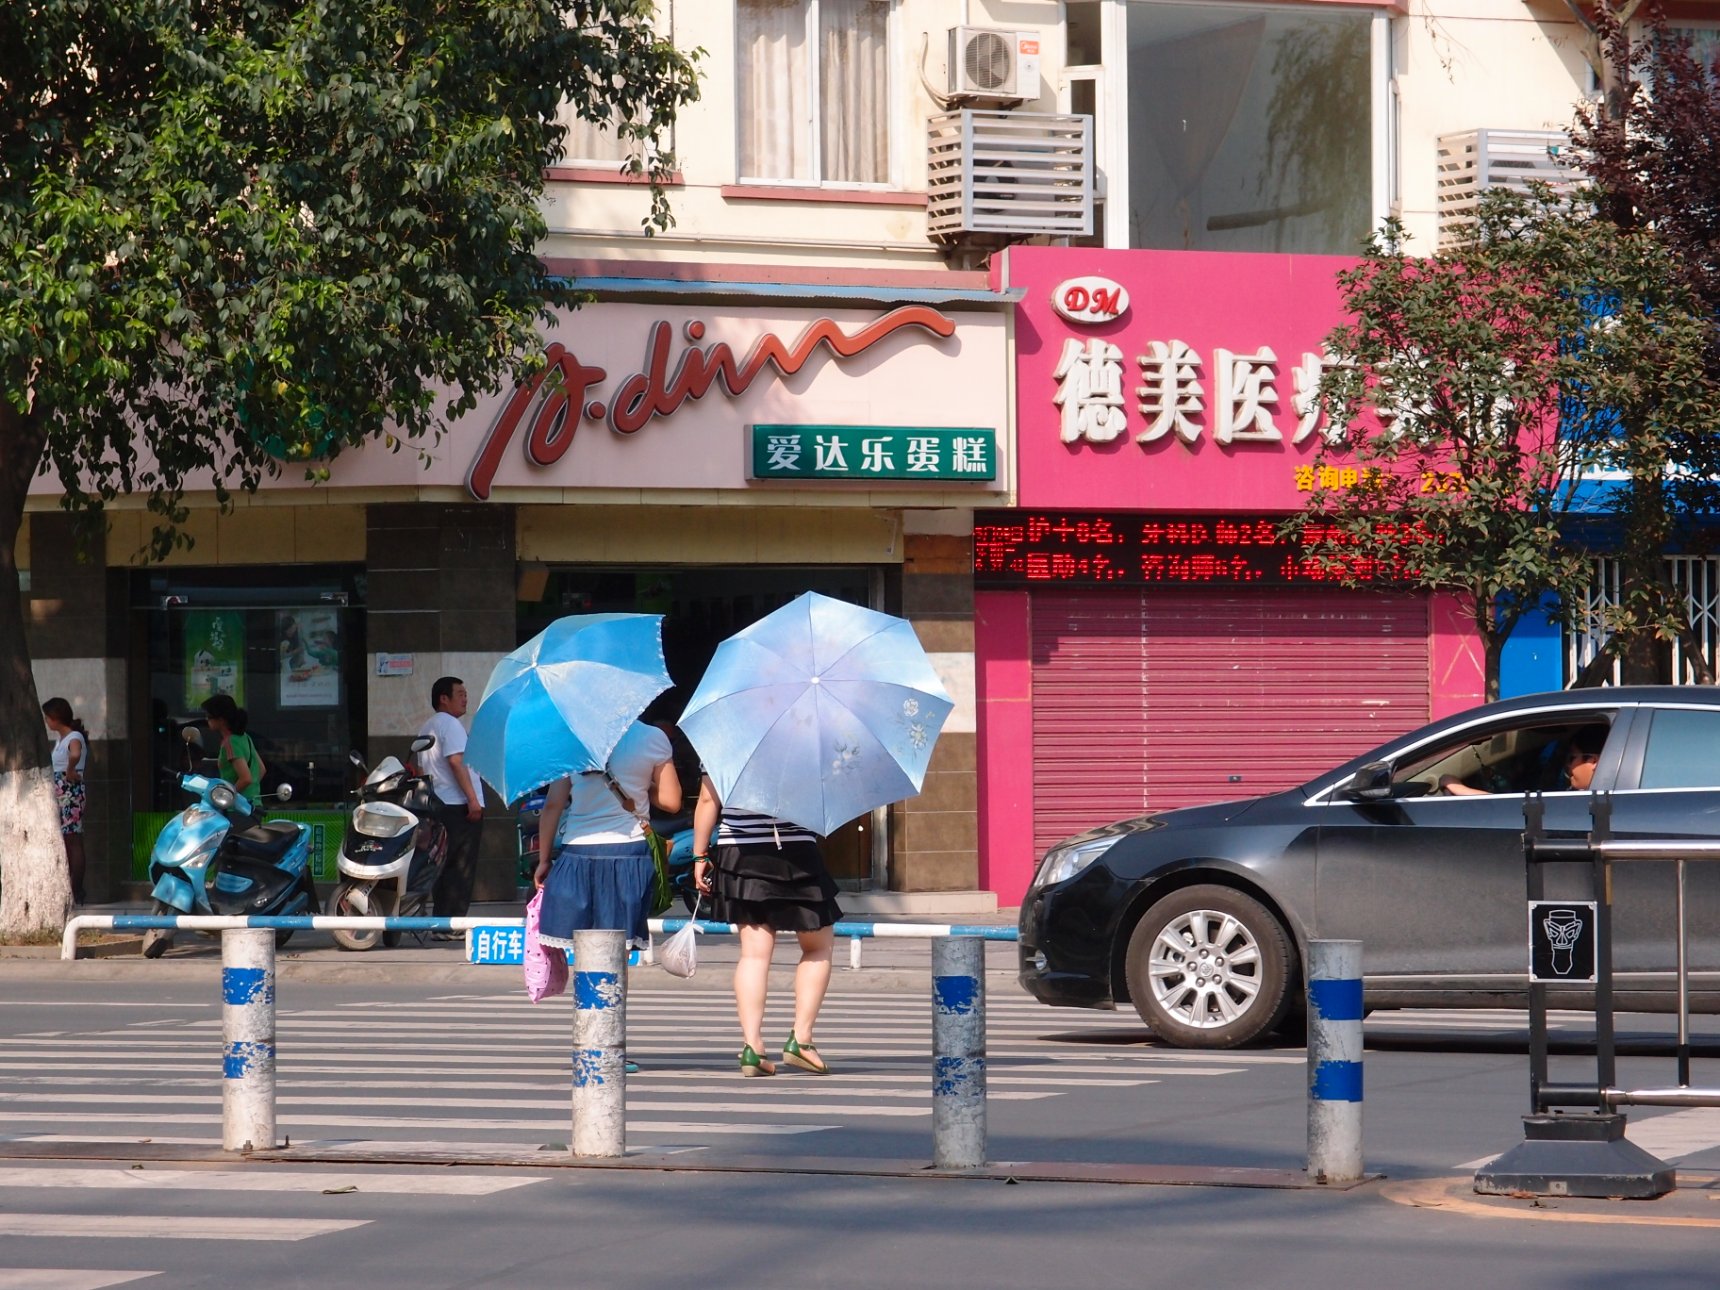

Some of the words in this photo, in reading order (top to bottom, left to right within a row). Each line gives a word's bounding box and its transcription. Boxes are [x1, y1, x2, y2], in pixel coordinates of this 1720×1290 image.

[1064, 286, 1120, 315] DM
[766, 434, 988, 473] 爱达乐蛋糕
[477, 930, 523, 961] 自行车
